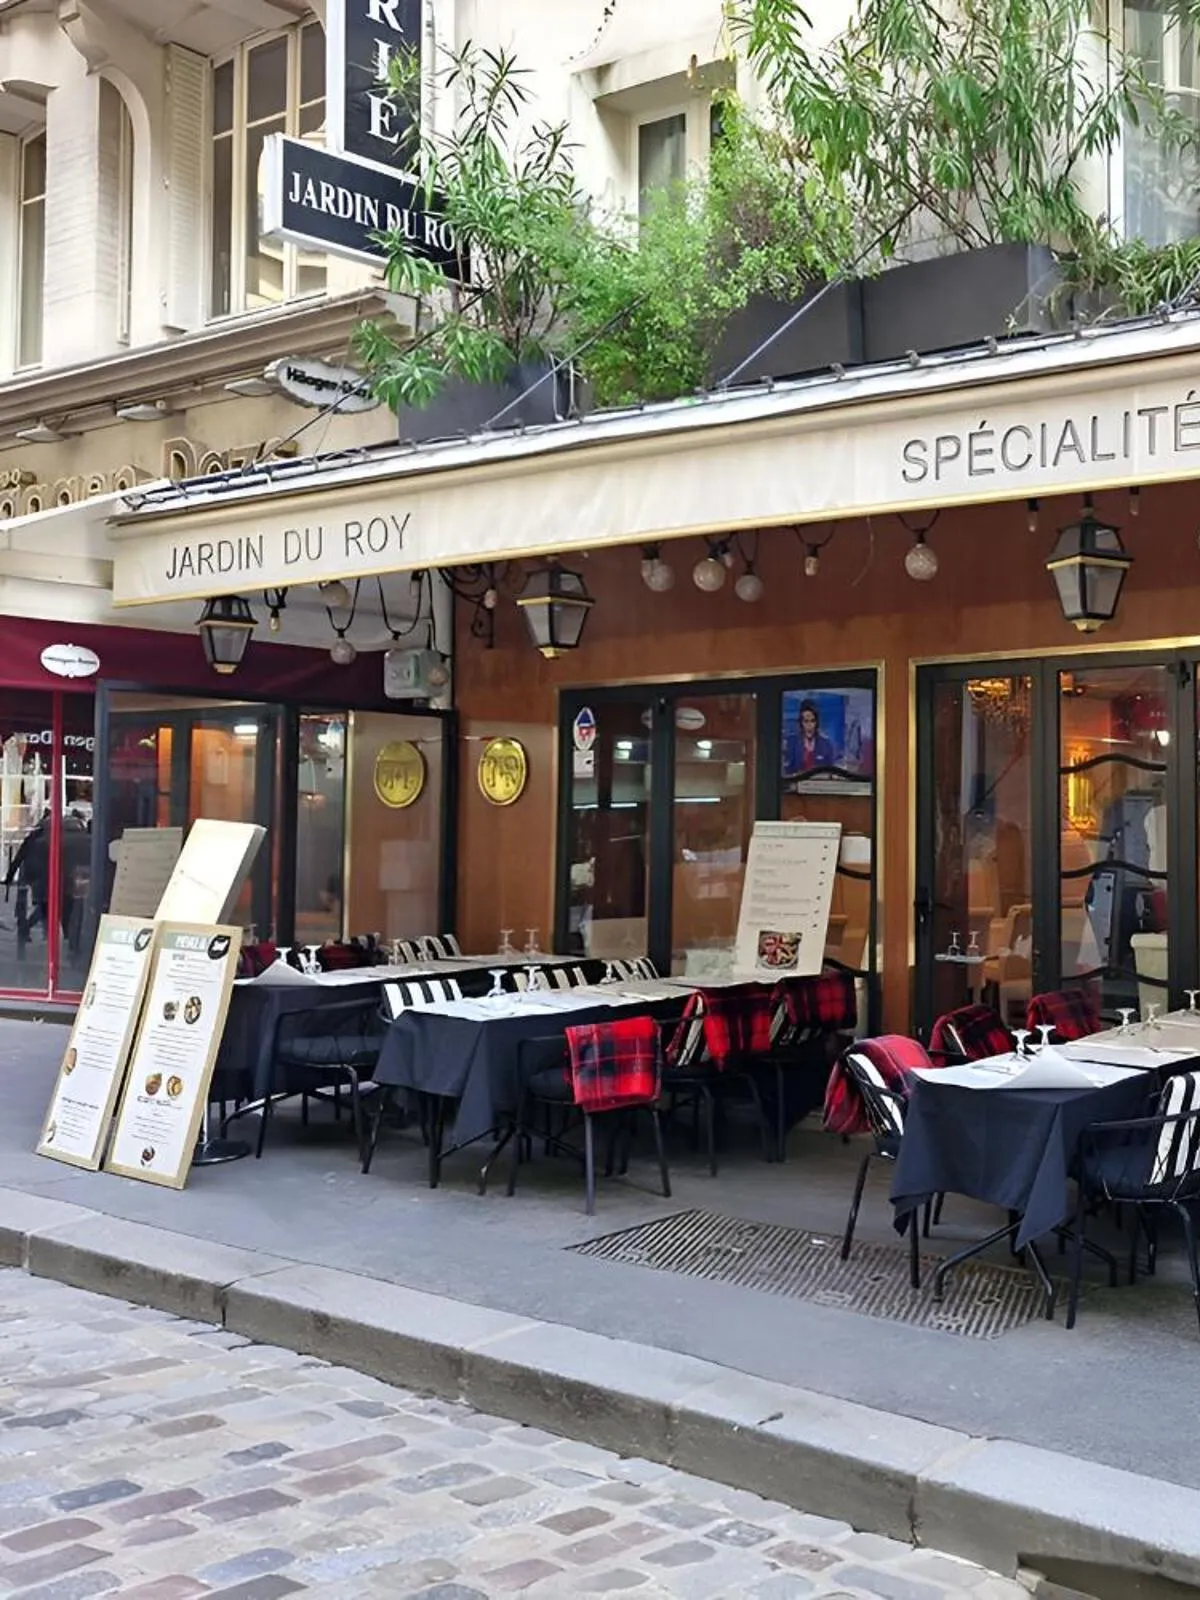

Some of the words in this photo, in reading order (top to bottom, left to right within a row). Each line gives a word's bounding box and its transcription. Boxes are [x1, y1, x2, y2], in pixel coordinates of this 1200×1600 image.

[289, 172, 380, 228] JARDIN
[386, 202, 418, 241] DU
[424, 217, 462, 253] RO
[166, 534, 263, 580] JARDIN
[284, 526, 323, 564] DU
[345, 512, 412, 557] ROY
